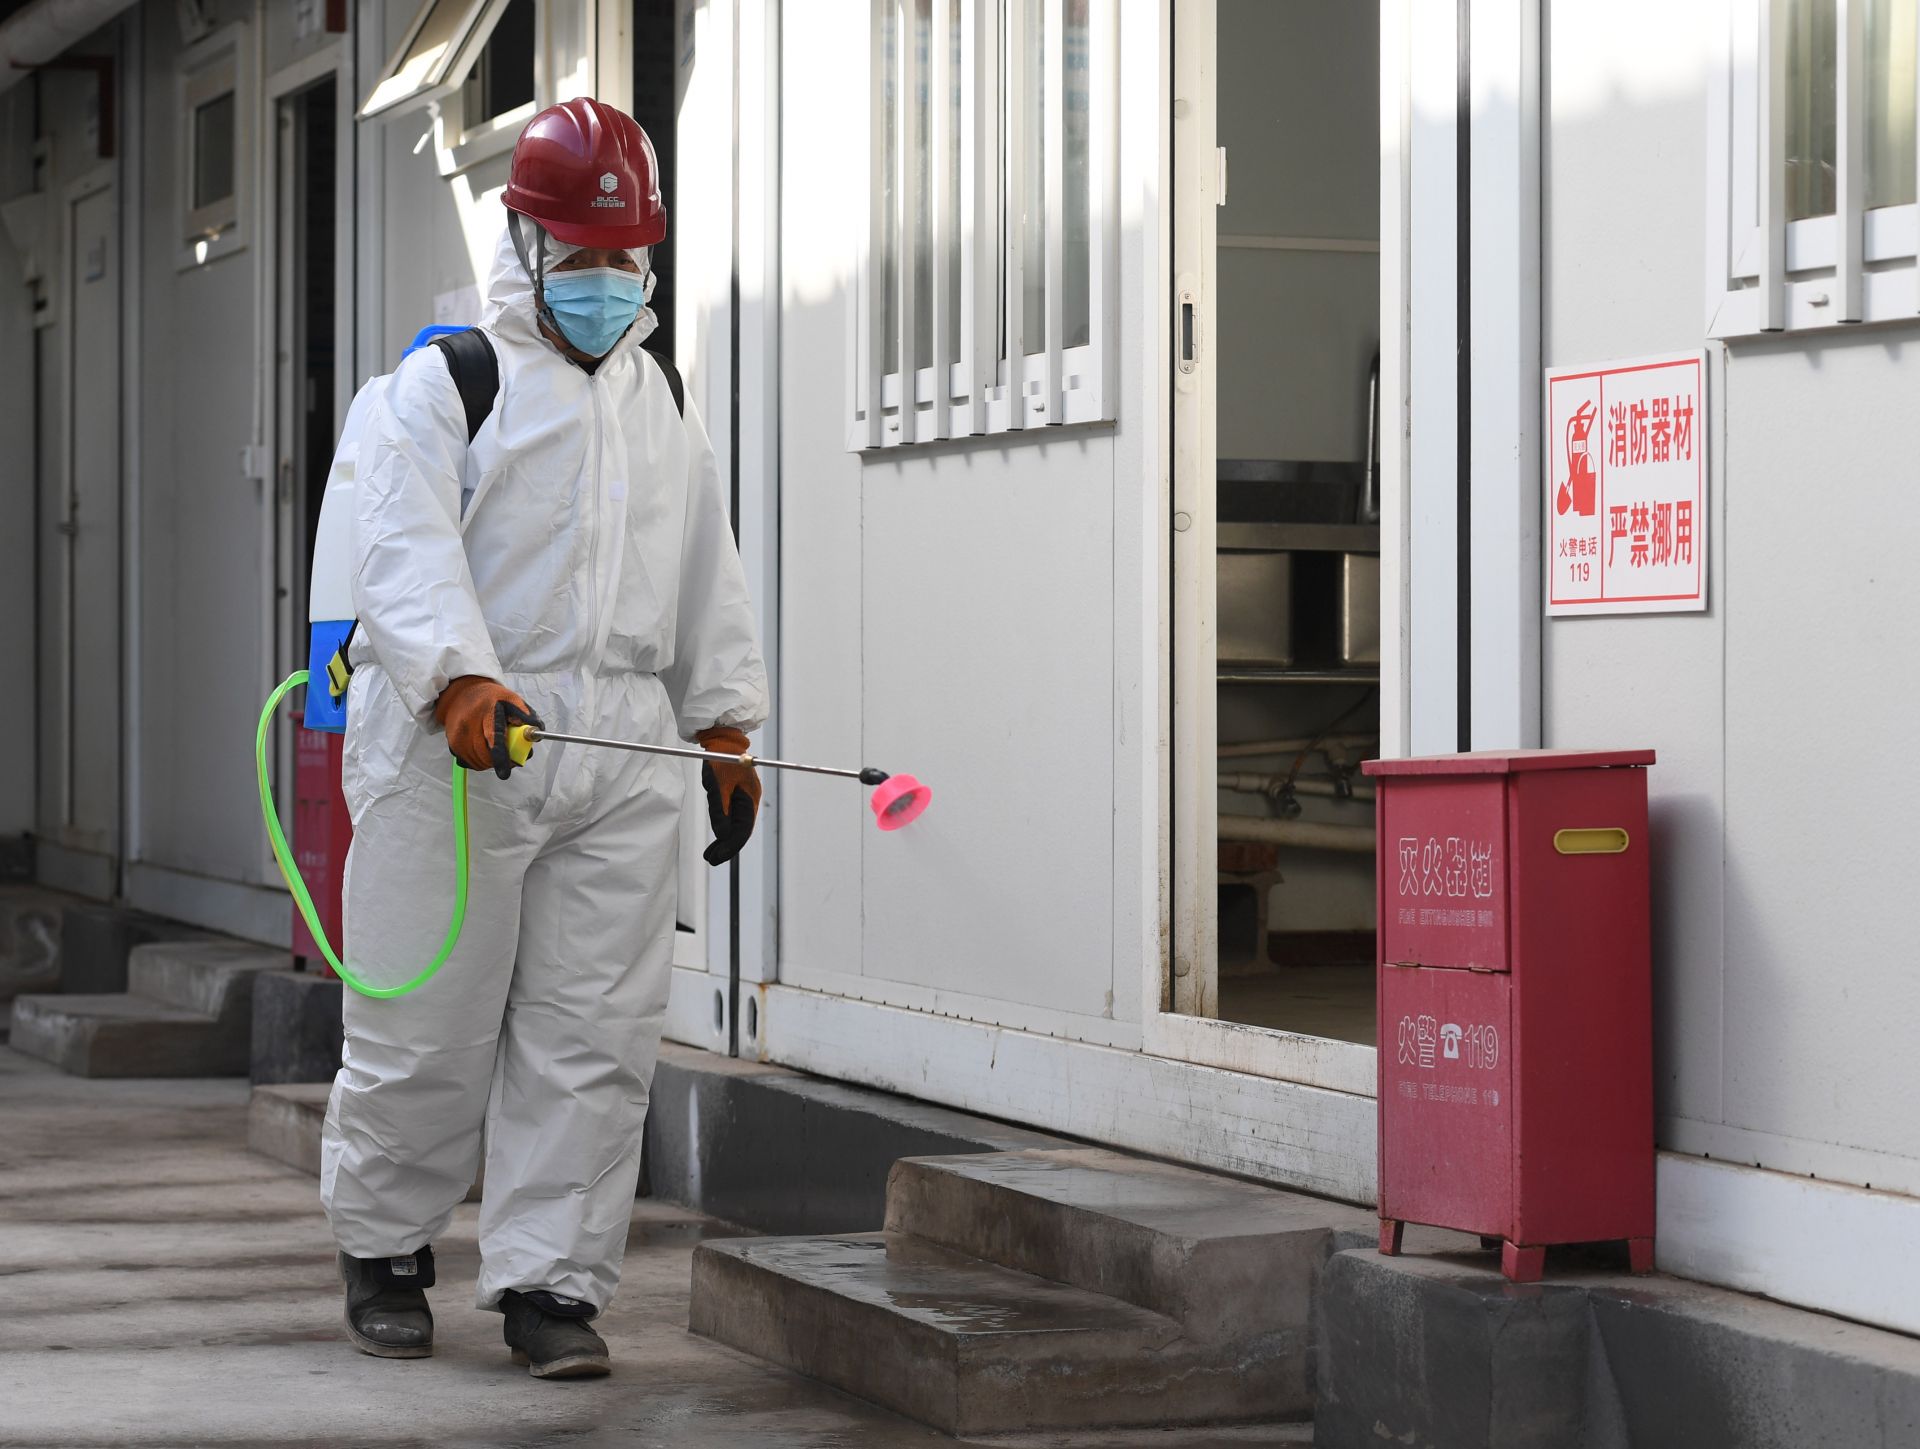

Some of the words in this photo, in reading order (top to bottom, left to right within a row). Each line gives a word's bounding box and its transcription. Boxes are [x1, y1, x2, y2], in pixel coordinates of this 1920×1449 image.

[1608, 394, 1694, 467] 消防器材
[1559, 537, 1597, 557] 火警电话
[1608, 500, 1693, 568] 严禁挪用
[1570, 562, 1590, 582] 119
[1399, 1015, 1437, 1068] 火警
[1465, 1024, 1499, 1070] 119
